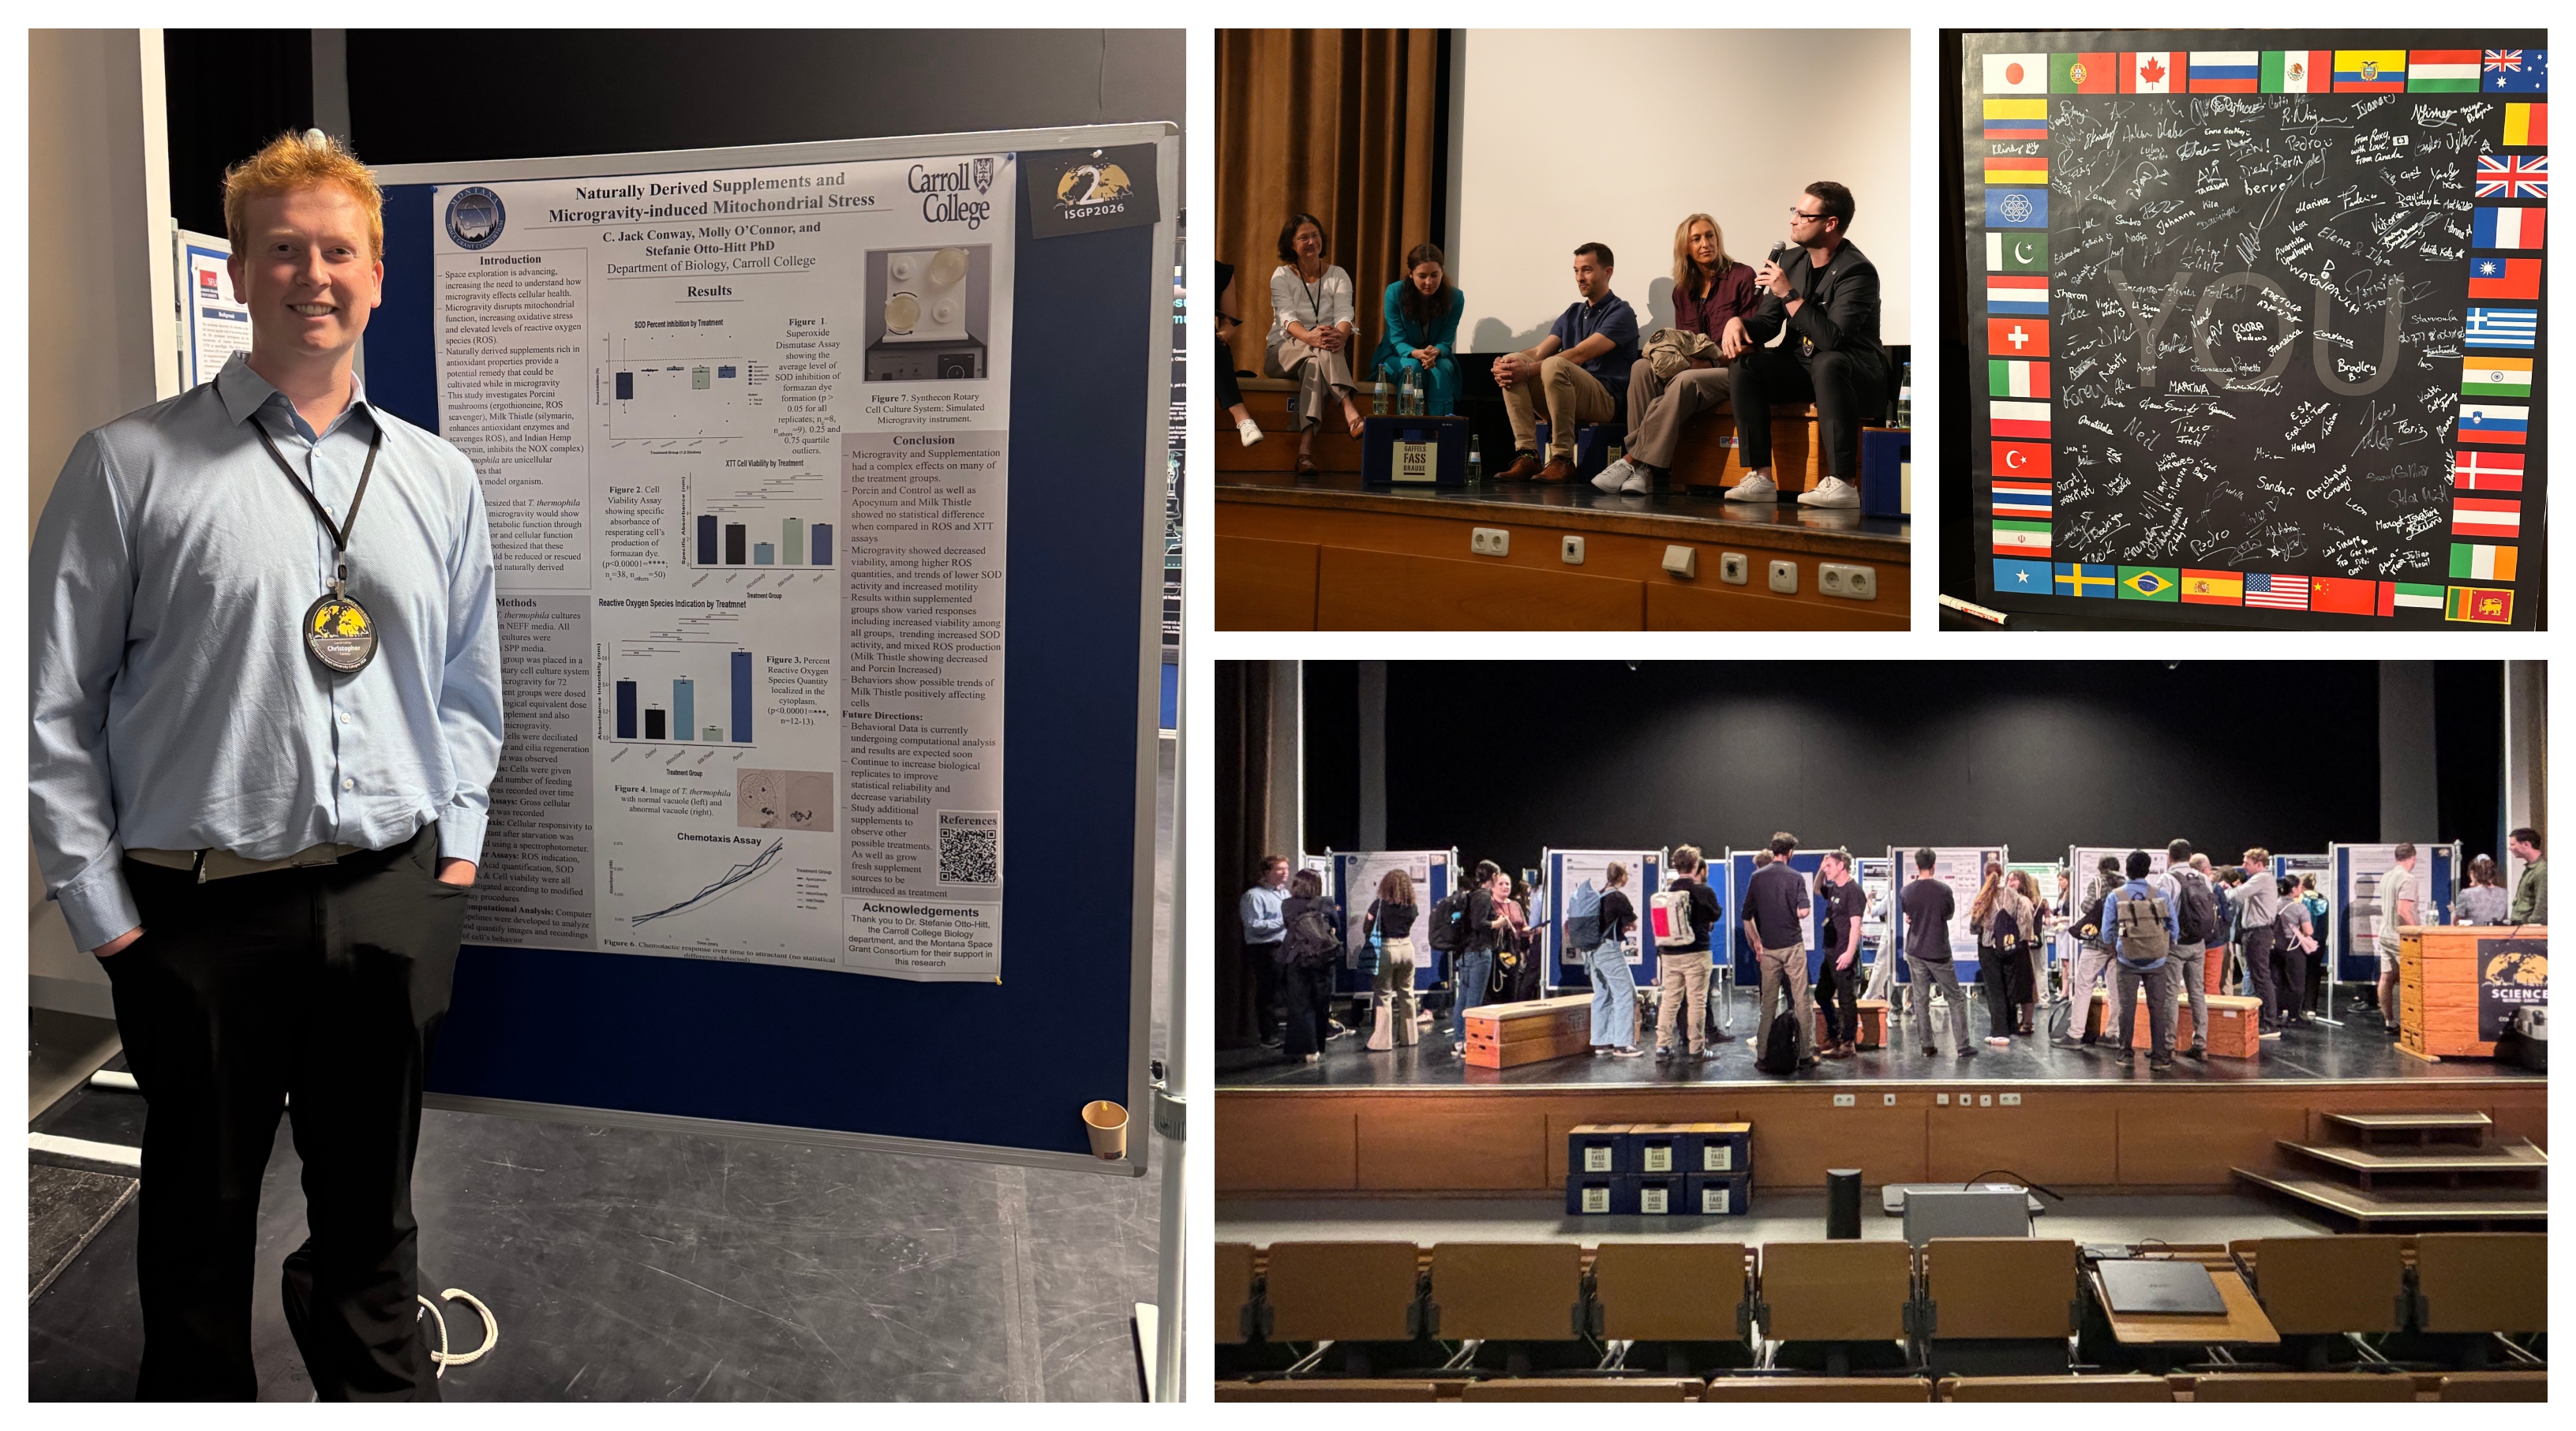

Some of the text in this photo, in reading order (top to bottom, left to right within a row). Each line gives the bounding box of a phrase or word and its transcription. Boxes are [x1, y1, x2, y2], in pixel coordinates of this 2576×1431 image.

[2352, 98, 2384, 119] Ivana
[2286, 135, 2323, 151] Pedro
[2369, 129, 2390, 144] Roxy,
[2351, 144, 2366, 155] with
[2356, 148, 2403, 164] from Canada
[576, 172, 845, 200] Naturally Derived Supplements and
[908, 164, 970, 193] Carroll
[1076, 166, 1105, 205] 2
[451, 188, 498, 205] MONTANA
[549, 193, 875, 223] Microgravity-induced Mitochondrial Stress
[923, 193, 990, 229] College
[1065, 204, 1125, 220] ISGP2026
[2156, 211, 2196, 235] Johanna
[447, 219, 504, 249] SPACE GRANT CONSORTIUM
[603, 232, 615, 242] C.
[618, 230, 643, 242] Jack
[647, 229, 695, 242] Conway,
[698, 227, 731, 240] Molly
[799, 222, 820, 233] and
[2125, 233, 2147, 245] Nadja
[646, 240, 774, 257] Stefanie Otto-Hitt PhD
[2276, 237, 2305, 260] Avantika
[2318, 227, 2350, 248] Elena
[2366, 247, 2393, 266] Ilya
[480, 255, 541, 266] Introduction
[608, 255, 815, 276] Department of Biology, Carroll College
[468, 270, 508, 279] exploration
[687, 285, 732, 298] Results
[2054, 289, 2087, 301] Sharon
[445, 303, 492, 312] Microgravity
[524, 301, 574, 309] mitochondrial
[2061, 298, 2091, 325] Alice
[789, 318, 815, 328] Figure
[786, 329, 829, 339] Superoxide
[2109, 269, 2404, 396] YOU
[776, 340, 841, 349] Dismutase Assay
[2338, 358, 2376, 375] Bradley
[2170, 380, 2209, 395] MARTINA
[871, 395, 899, 404] Figure
[912, 394, 950, 403] Synthecon
[893, 436, 955, 445] Conclusion
[852, 451, 907, 460] Microgravity
[928, 449, 1001, 459] Supplementation
[1404, 453, 1425, 463] FASS
[609, 485, 635, 494] Figure
[608, 496, 661, 505] Viability Assay
[2346, 497, 2367, 515] Leon
[2376, 515, 2405, 534] Margot
[2190, 530, 2230, 556] Pedro
[496, 598, 537, 607] Methods
[626, 599, 649, 609] Oxygen
[650, 599, 673, 609] Species
[675, 599, 706, 608] Indication
[706, 599, 714, 609] by
[716, 599, 746, 609] Treatmnet
[504, 612, 549, 620] thermophila
[766, 655, 792, 665] Figure
[842, 710, 923, 721] Future Directions:
[940, 815, 997, 826] References
[677, 833, 762, 846] Chemotaxis Assay
[863, 902, 979, 917] Acknowledgements
[2492, 989, 2548, 998] SCIENCE
